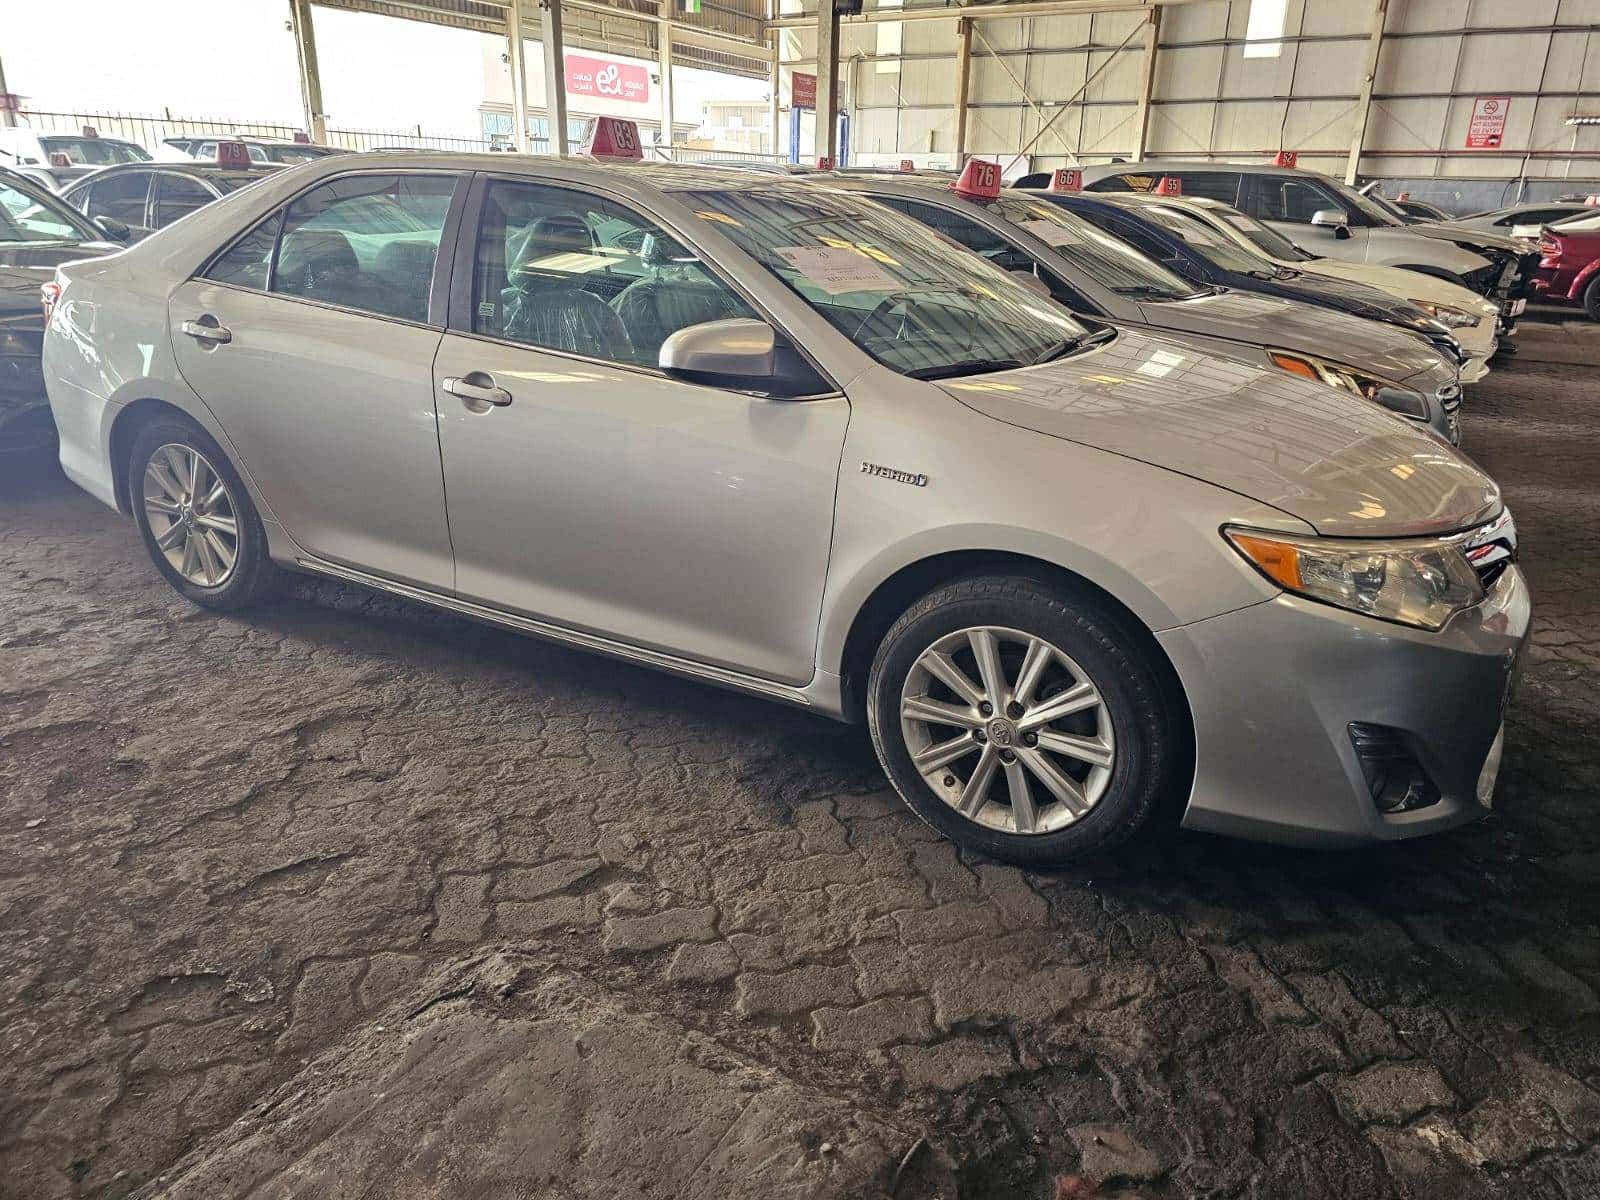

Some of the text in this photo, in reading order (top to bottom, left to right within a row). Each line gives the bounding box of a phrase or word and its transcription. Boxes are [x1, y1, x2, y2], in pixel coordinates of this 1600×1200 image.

[613, 120, 636, 150] 83
[224, 143, 240, 159] 79
[976, 165, 994, 188] 76
[1060, 170, 1074, 185] 66
[1167, 178, 1178, 191] 55
[860, 462, 917, 485] HYBRID
